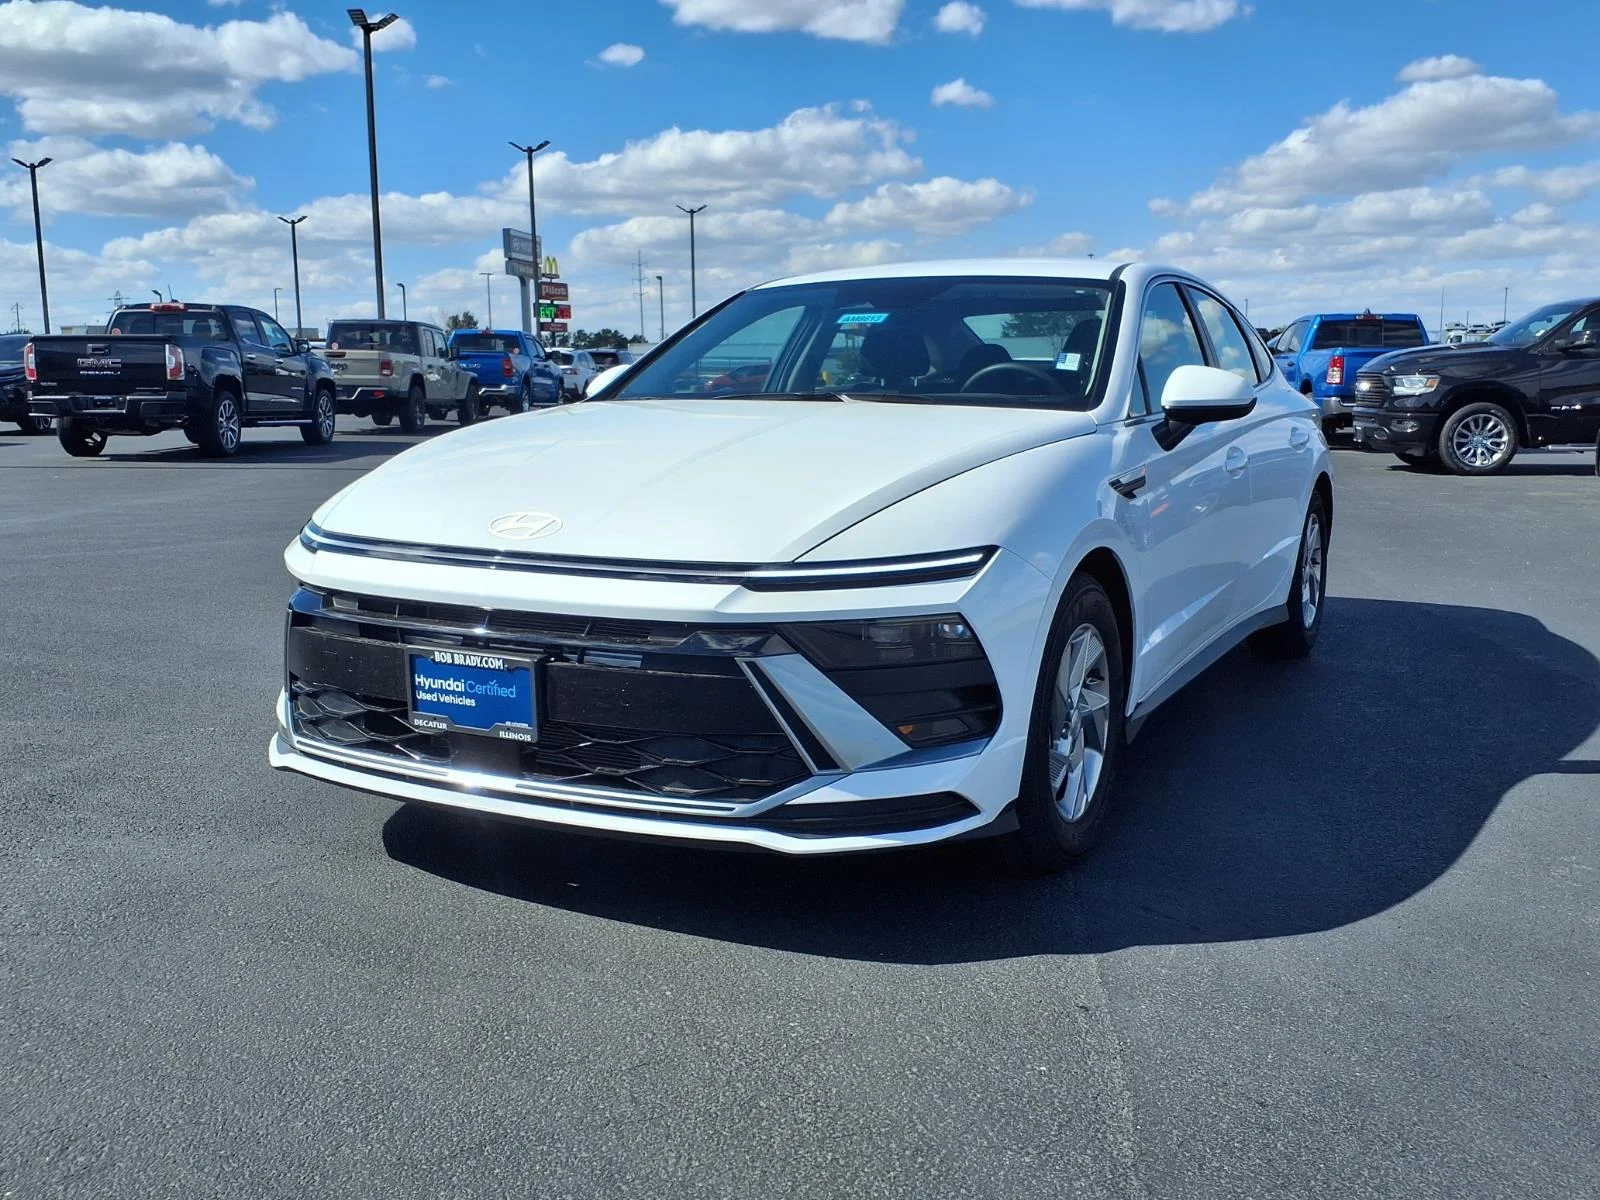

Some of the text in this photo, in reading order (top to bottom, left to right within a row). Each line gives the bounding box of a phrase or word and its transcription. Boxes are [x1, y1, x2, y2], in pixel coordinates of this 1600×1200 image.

[541, 285, 567, 296] Pilot
[77, 358, 122, 368] GMC
[434, 651, 504, 669] BOB BRADY.COM
[415, 674, 517, 698] Hyundai Certified
[416, 691, 476, 707] Used Vehicles
[414, 719, 448, 730] DECATUR
[499, 730, 532, 742] ILLINOIS
